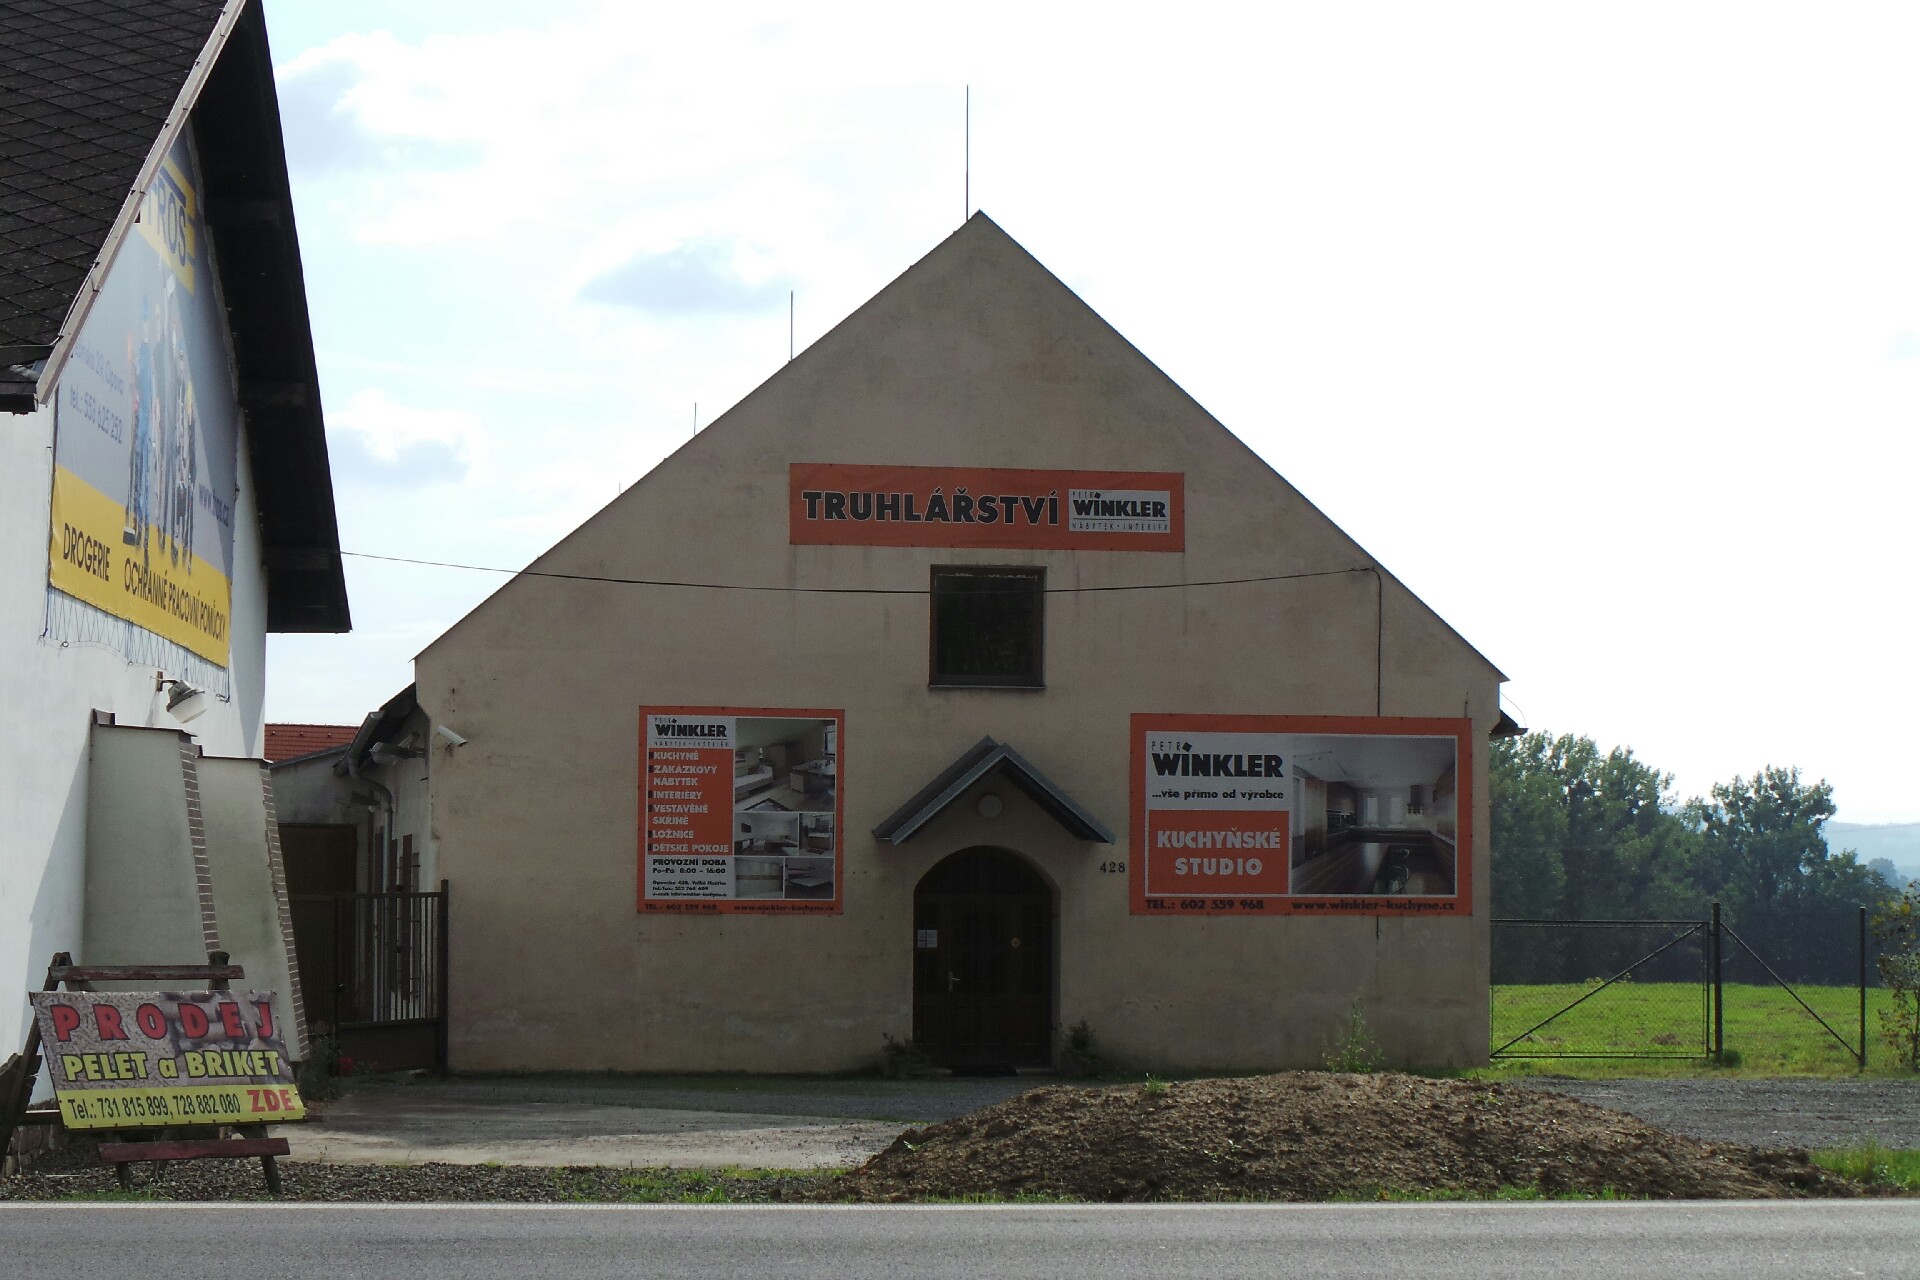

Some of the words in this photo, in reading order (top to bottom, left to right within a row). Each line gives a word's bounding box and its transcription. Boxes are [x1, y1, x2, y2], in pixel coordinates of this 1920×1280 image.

[1072, 491, 1094, 499] PETR
[802, 487, 1059, 526] TRUHLÁŘSTVÍ
[1072, 498, 1167, 518] WINKLER
[63, 522, 111, 583] DROGERIE
[124, 557, 168, 611] OCHRANNÉ
[168, 584, 200, 631] PRACOVNÍ
[654, 722, 727, 737] WINKLER
[1151, 741, 1181, 751] PETR
[1151, 751, 1284, 778] WINKLER
[1222, 789, 1237, 799] od
[1240, 789, 1284, 801] výrobce
[652, 829, 695, 839] LOŽNICE
[1157, 827, 1281, 849] KUCHYŇSKÉ
[691, 844, 729, 853] POKOJE
[652, 858, 699, 866] PROVOZNÍ
[1099, 861, 1126, 874] 428
[1174, 858, 1263, 876] STUDIO
[1145, 899, 1176, 910] TEL.:
[1180, 899, 1206, 910] 602
[1210, 899, 1235, 910] 559
[1239, 899, 1265, 910] 968
[1291, 900, 1456, 912] www.winkler-kuchyne.cz
[50, 1001, 275, 1043] PRODEJ
[60, 1052, 149, 1082] PELET
[157, 1056, 180, 1080] a
[183, 1050, 282, 1079] BRIKET
[67, 1098, 98, 1120] Tel.:
[99, 1097, 121, 1119] 731
[122, 1096, 146, 1118] 815
[147, 1094, 174, 1120] 899,
[173, 1094, 197, 1116] 728
[199, 1093, 219, 1115] 882
[220, 1093, 241, 1115] 080
[246, 1088, 296, 1113] ZDE
